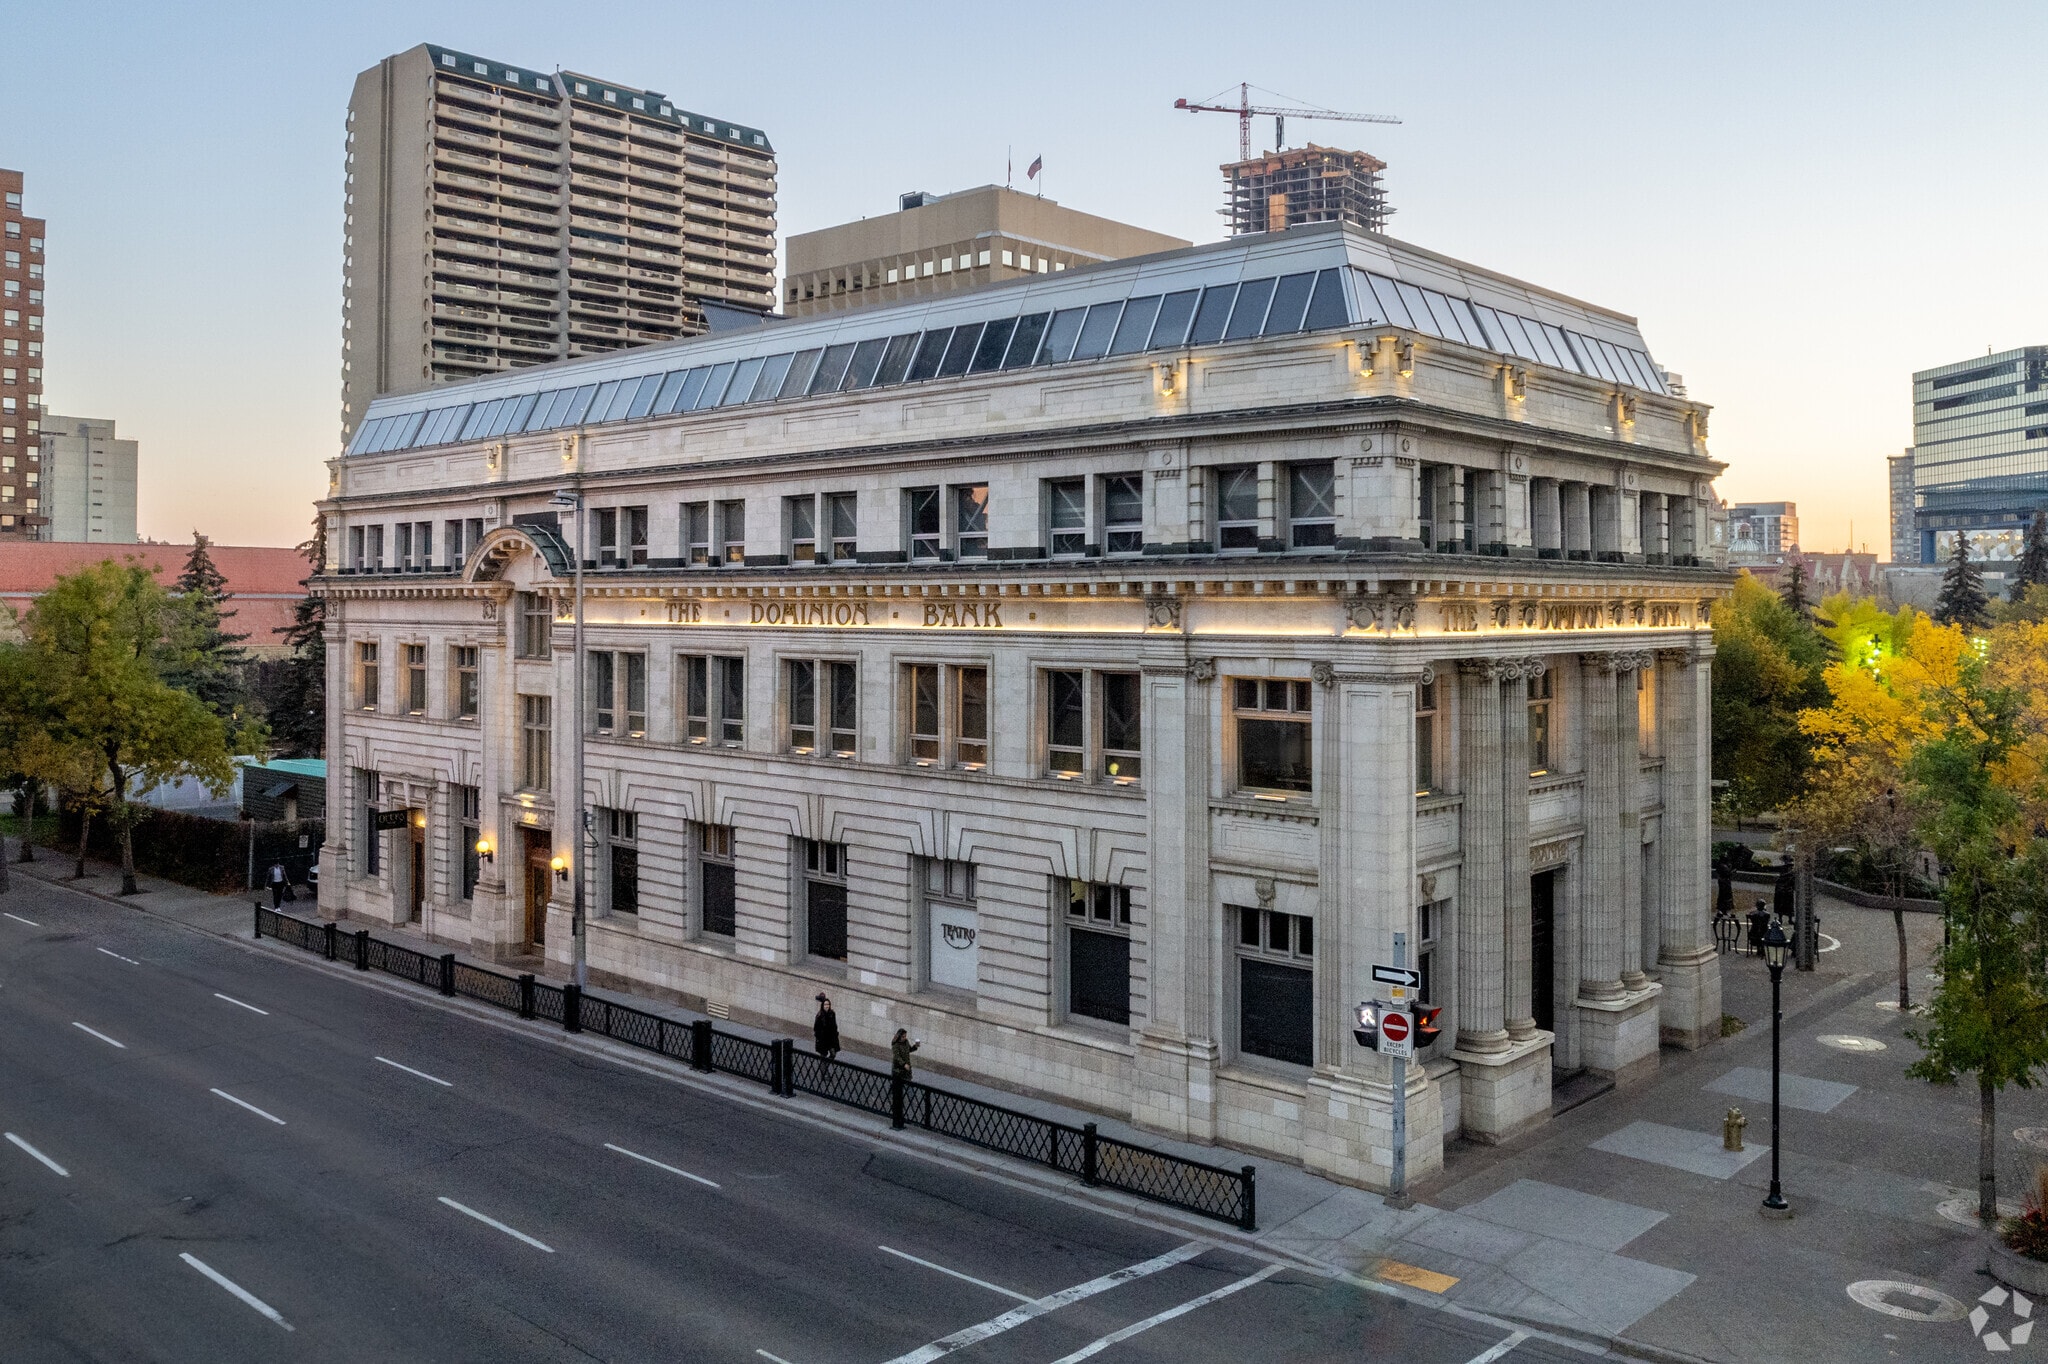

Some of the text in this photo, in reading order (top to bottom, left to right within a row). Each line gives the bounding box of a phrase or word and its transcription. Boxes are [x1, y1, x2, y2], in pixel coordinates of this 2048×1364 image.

[664, 602, 1003, 627] THE DOMINION BANK
[1439, 604, 1478, 632] THE
[941, 923, 976, 944] TEATRO
[1384, 1047, 1407, 1056] BICYCLES
[1387, 1041, 1404, 1049] EXCEPT
